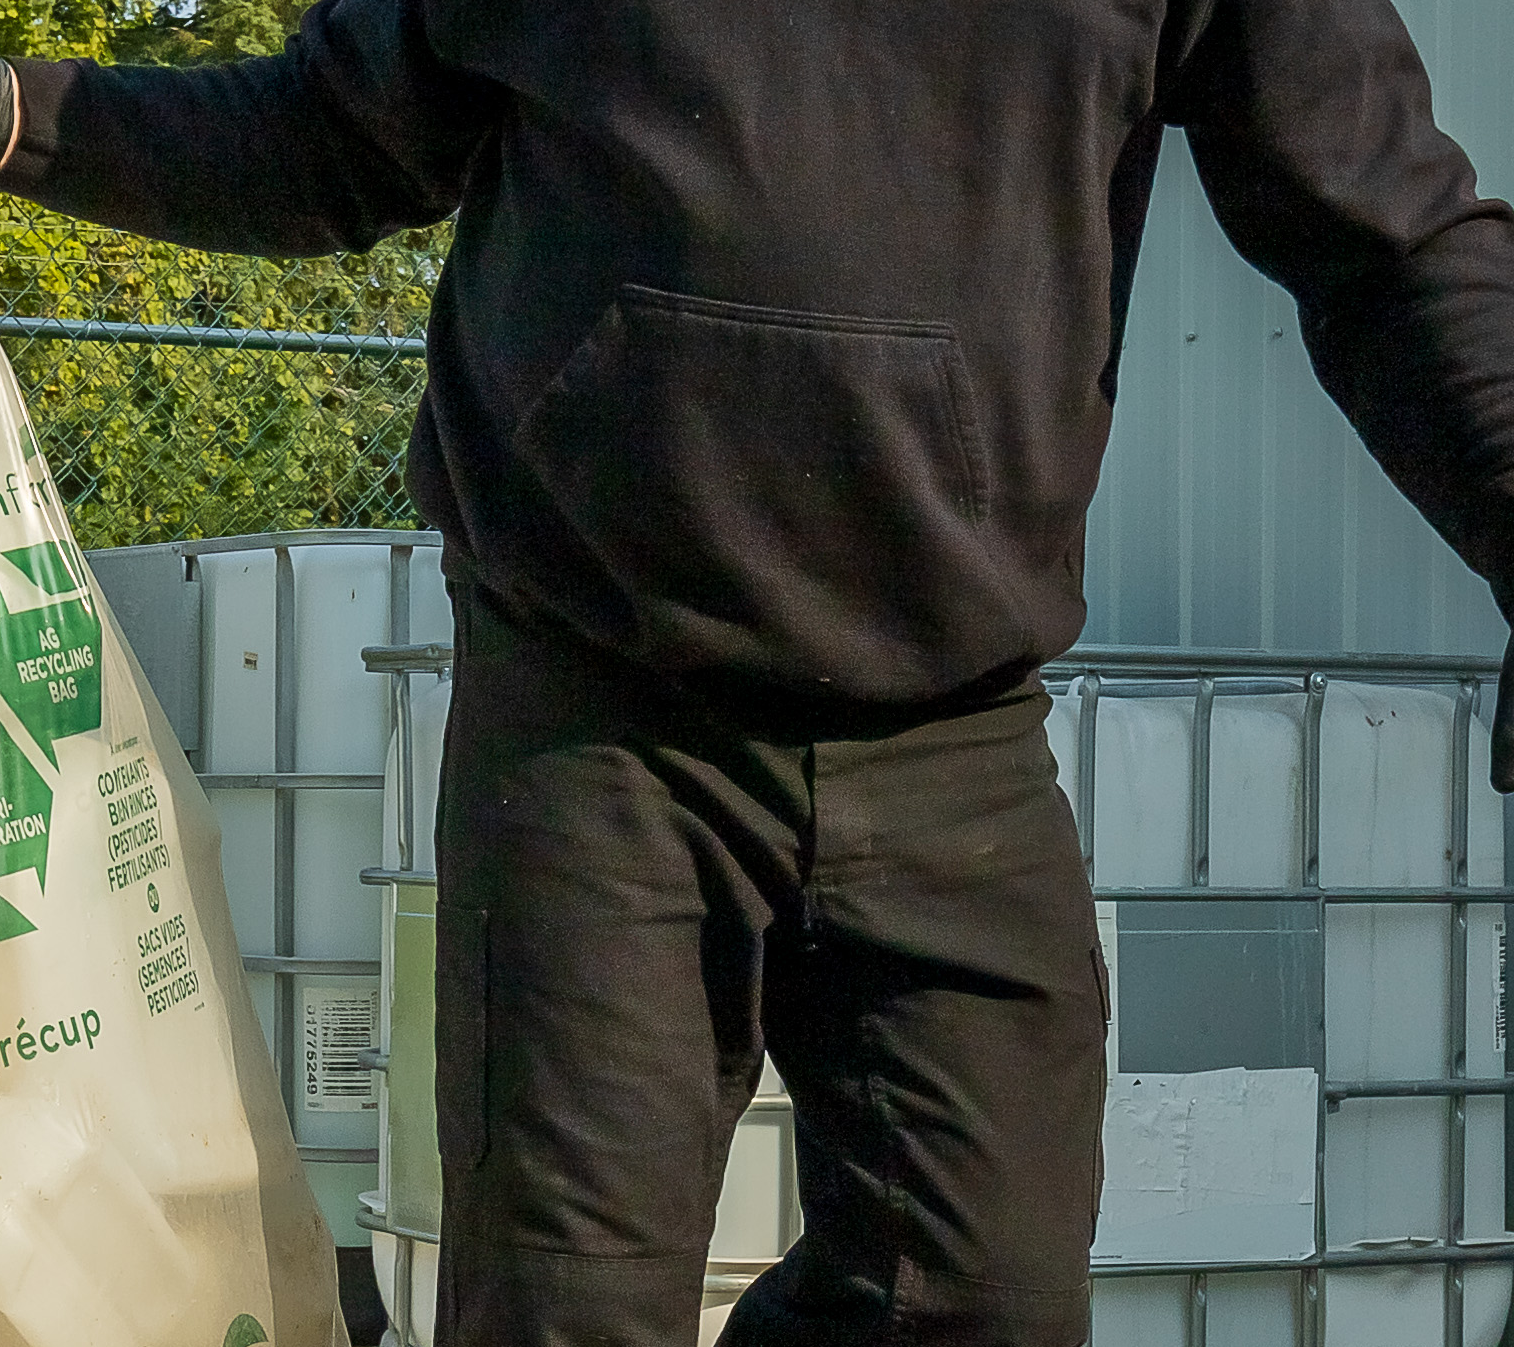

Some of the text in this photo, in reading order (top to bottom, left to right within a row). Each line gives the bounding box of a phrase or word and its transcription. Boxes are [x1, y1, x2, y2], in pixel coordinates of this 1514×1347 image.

[38, 626, 60, 652] AG
[16, 644, 94, 684] RECYCLING
[47, 675, 79, 704] BAG
[137, 928, 162, 959] SACS
[138, 945, 187, 993] (SEMENCES
